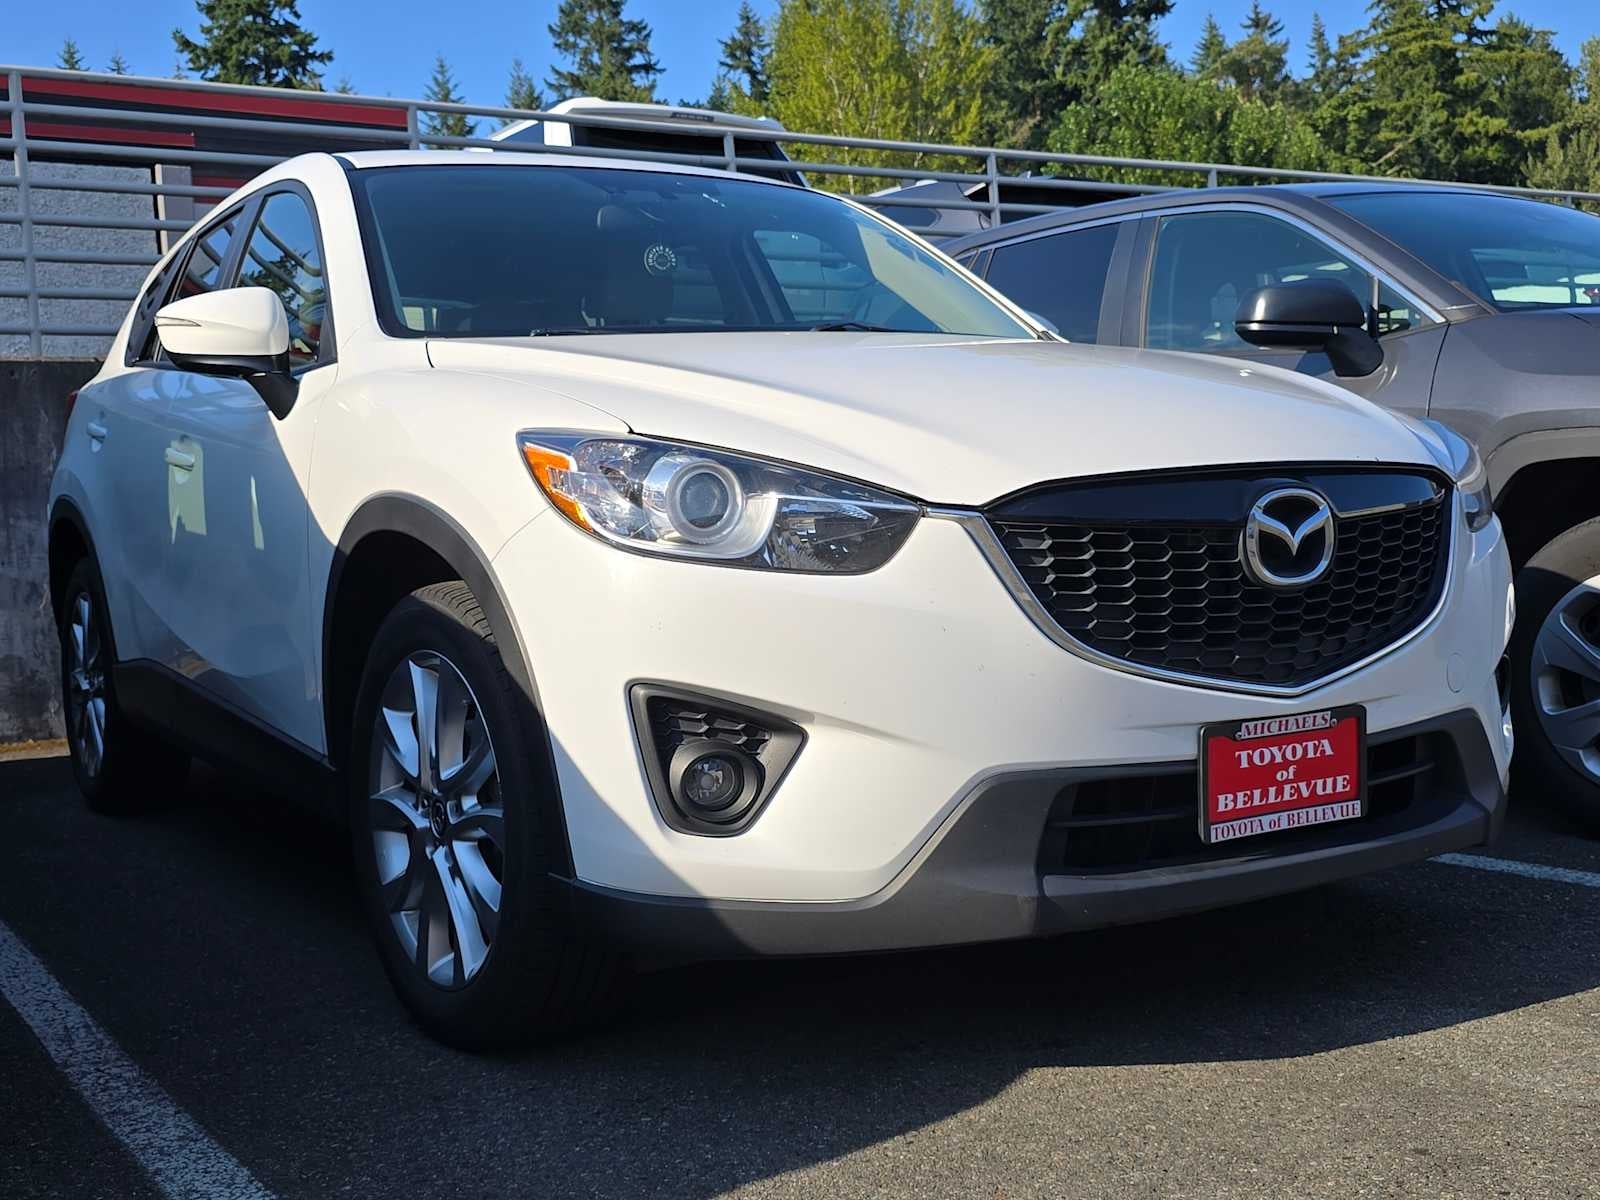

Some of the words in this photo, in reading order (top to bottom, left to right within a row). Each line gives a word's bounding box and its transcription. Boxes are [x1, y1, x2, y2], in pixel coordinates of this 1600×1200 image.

[1242, 713, 1330, 737] MICHAELS
[1235, 739, 1334, 768] TOYOTA
[1276, 765, 1297, 781] of
[1216, 775, 1351, 812] BELLEVUE
[1213, 819, 1264, 842] TOYOTA
[1268, 818, 1281, 830] of
[1287, 802, 1360, 826] BELLEVUE
